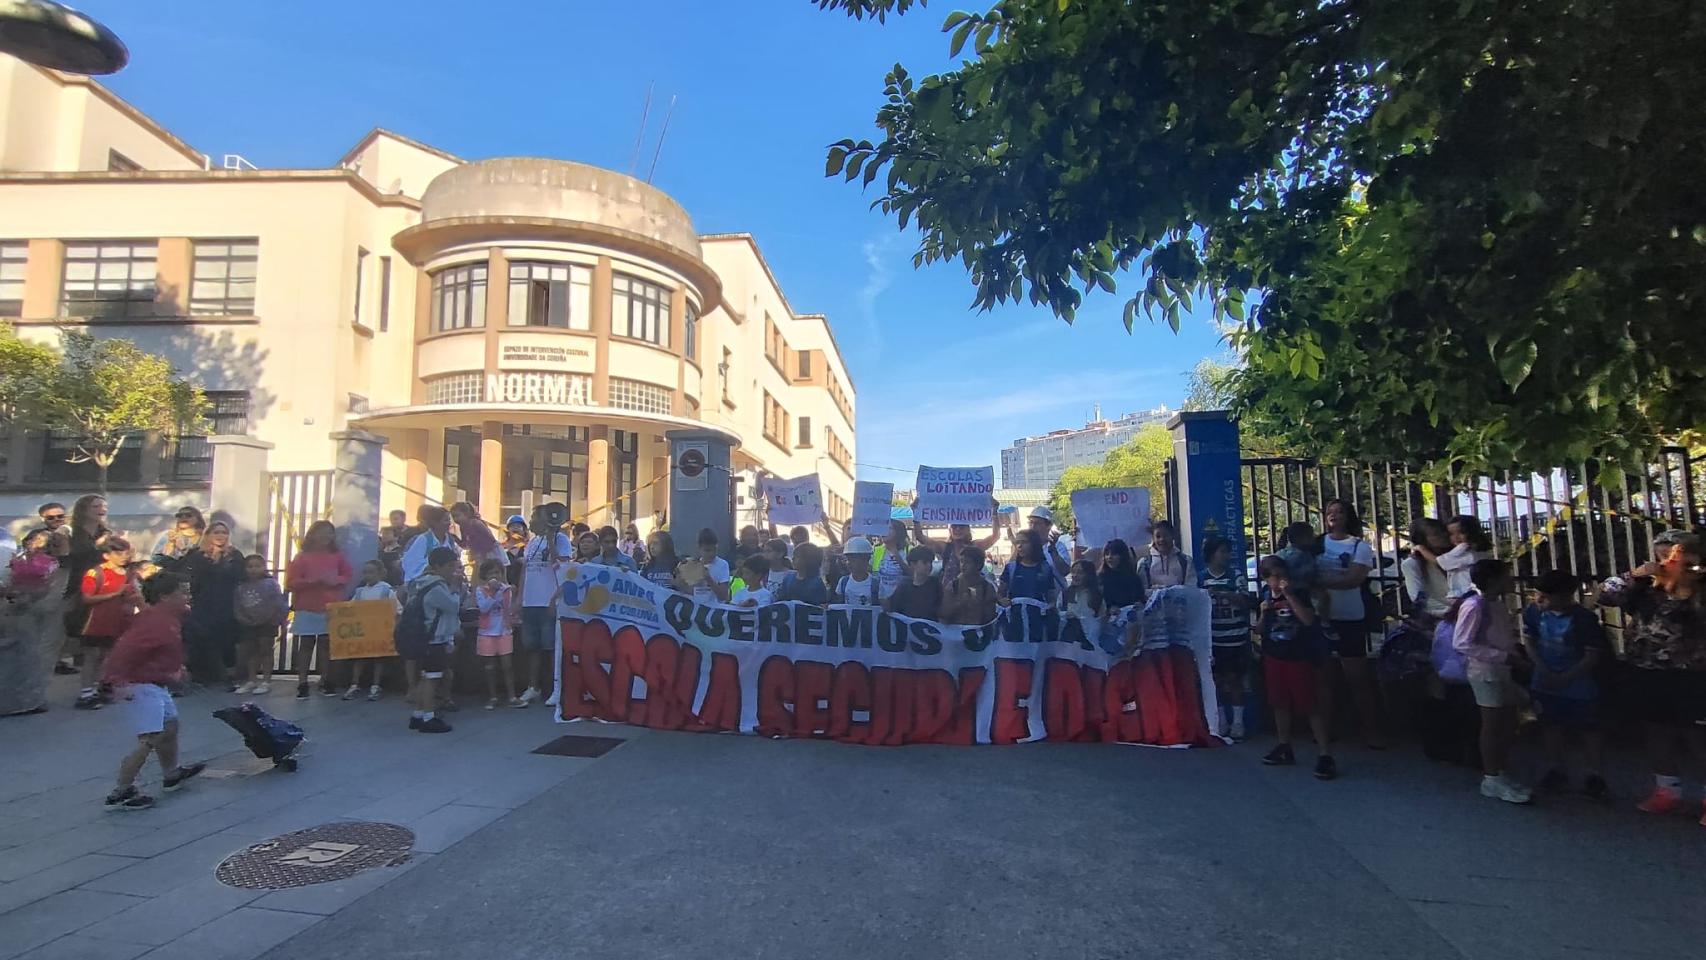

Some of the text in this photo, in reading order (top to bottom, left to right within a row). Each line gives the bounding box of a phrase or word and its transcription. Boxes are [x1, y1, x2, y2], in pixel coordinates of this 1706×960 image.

[487, 372, 599, 406] NORMAL
[920, 469, 984, 482] ESCOLAS
[663, 594, 943, 656] QUEREMOS
[560, 616, 742, 734] ESCOLA
[990, 656, 1036, 744] E
